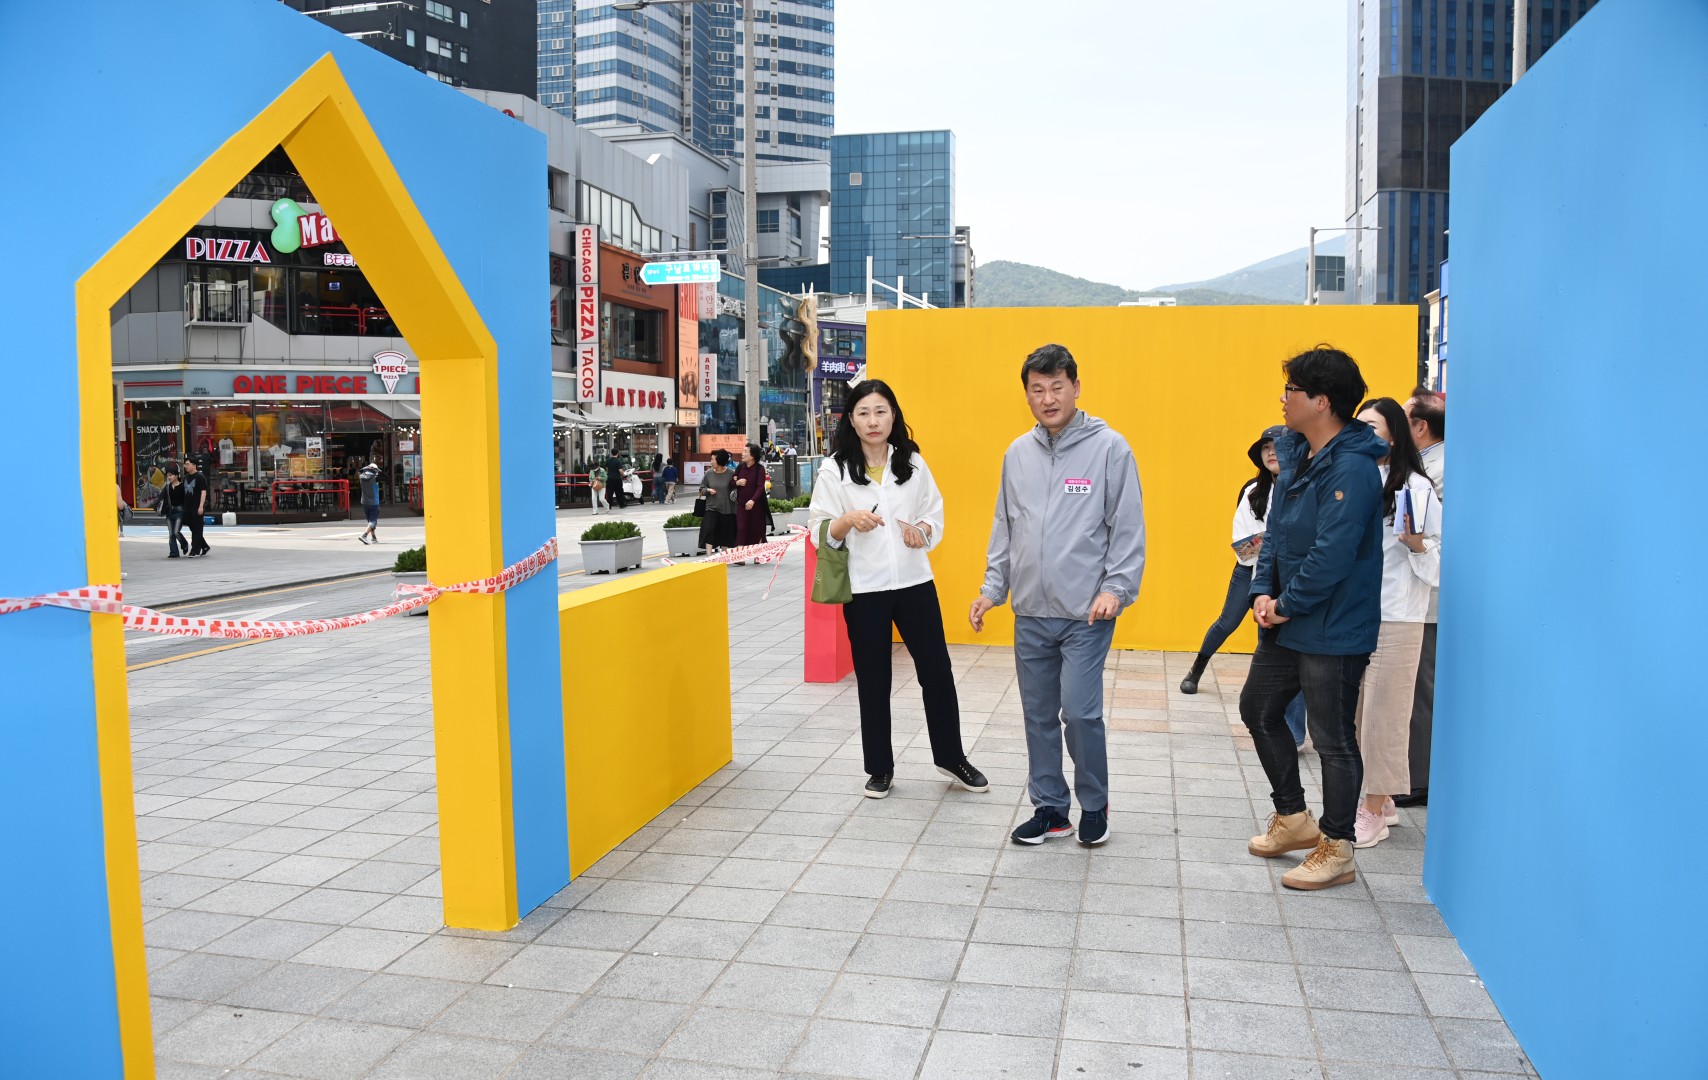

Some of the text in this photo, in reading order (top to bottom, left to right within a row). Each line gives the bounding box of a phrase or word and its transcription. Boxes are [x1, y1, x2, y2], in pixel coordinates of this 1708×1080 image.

[300, 215, 336, 246] Ma
[186, 237, 271, 263] PIZZA
[324, 252, 356, 267] BEE
[581, 228, 592, 283] CHICAGO
[580, 286, 595, 341] PIZZA
[380, 365, 407, 373] PIECE
[582, 347, 594, 399] TACOS
[821, 360, 846, 374] 羊肉串
[233, 375, 367, 395] ONE PIECE
[604, 386, 668, 410] ARTBOX
[136, 425, 180, 434] SNACK WRAP
